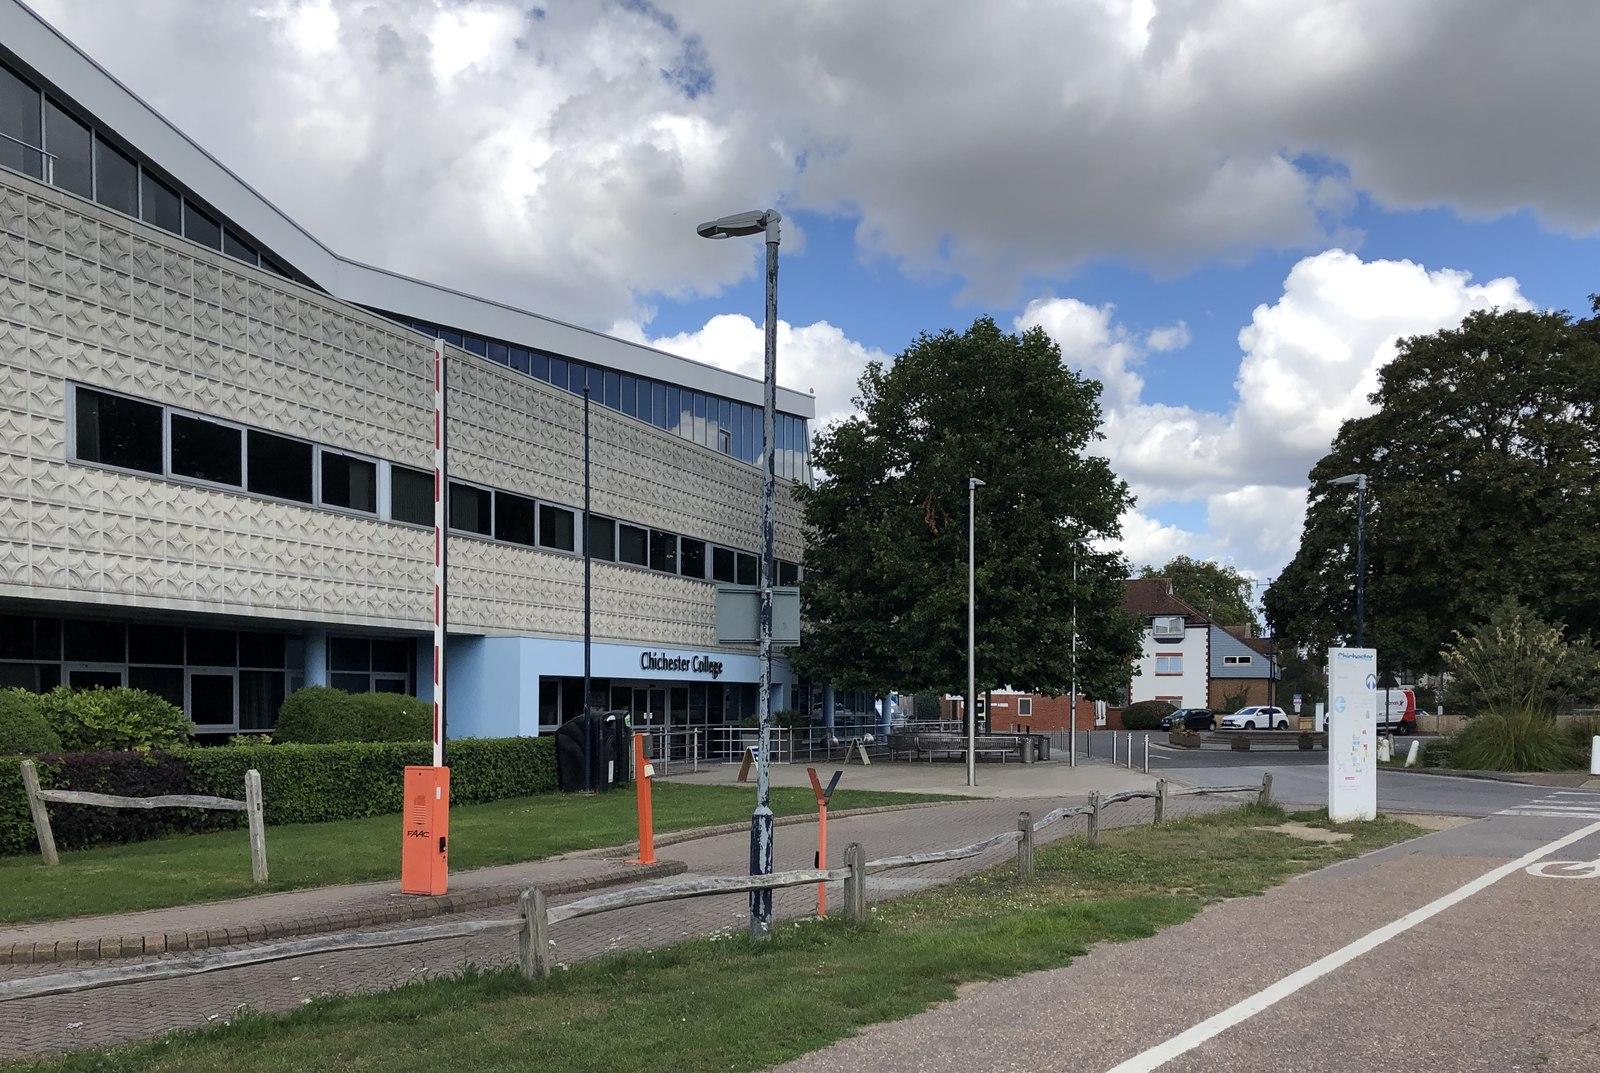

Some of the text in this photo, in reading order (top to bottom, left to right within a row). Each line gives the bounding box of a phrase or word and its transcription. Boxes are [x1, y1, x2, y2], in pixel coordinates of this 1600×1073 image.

[641, 651, 723, 680] Chichester College
[407, 829, 430, 838] FAAC
